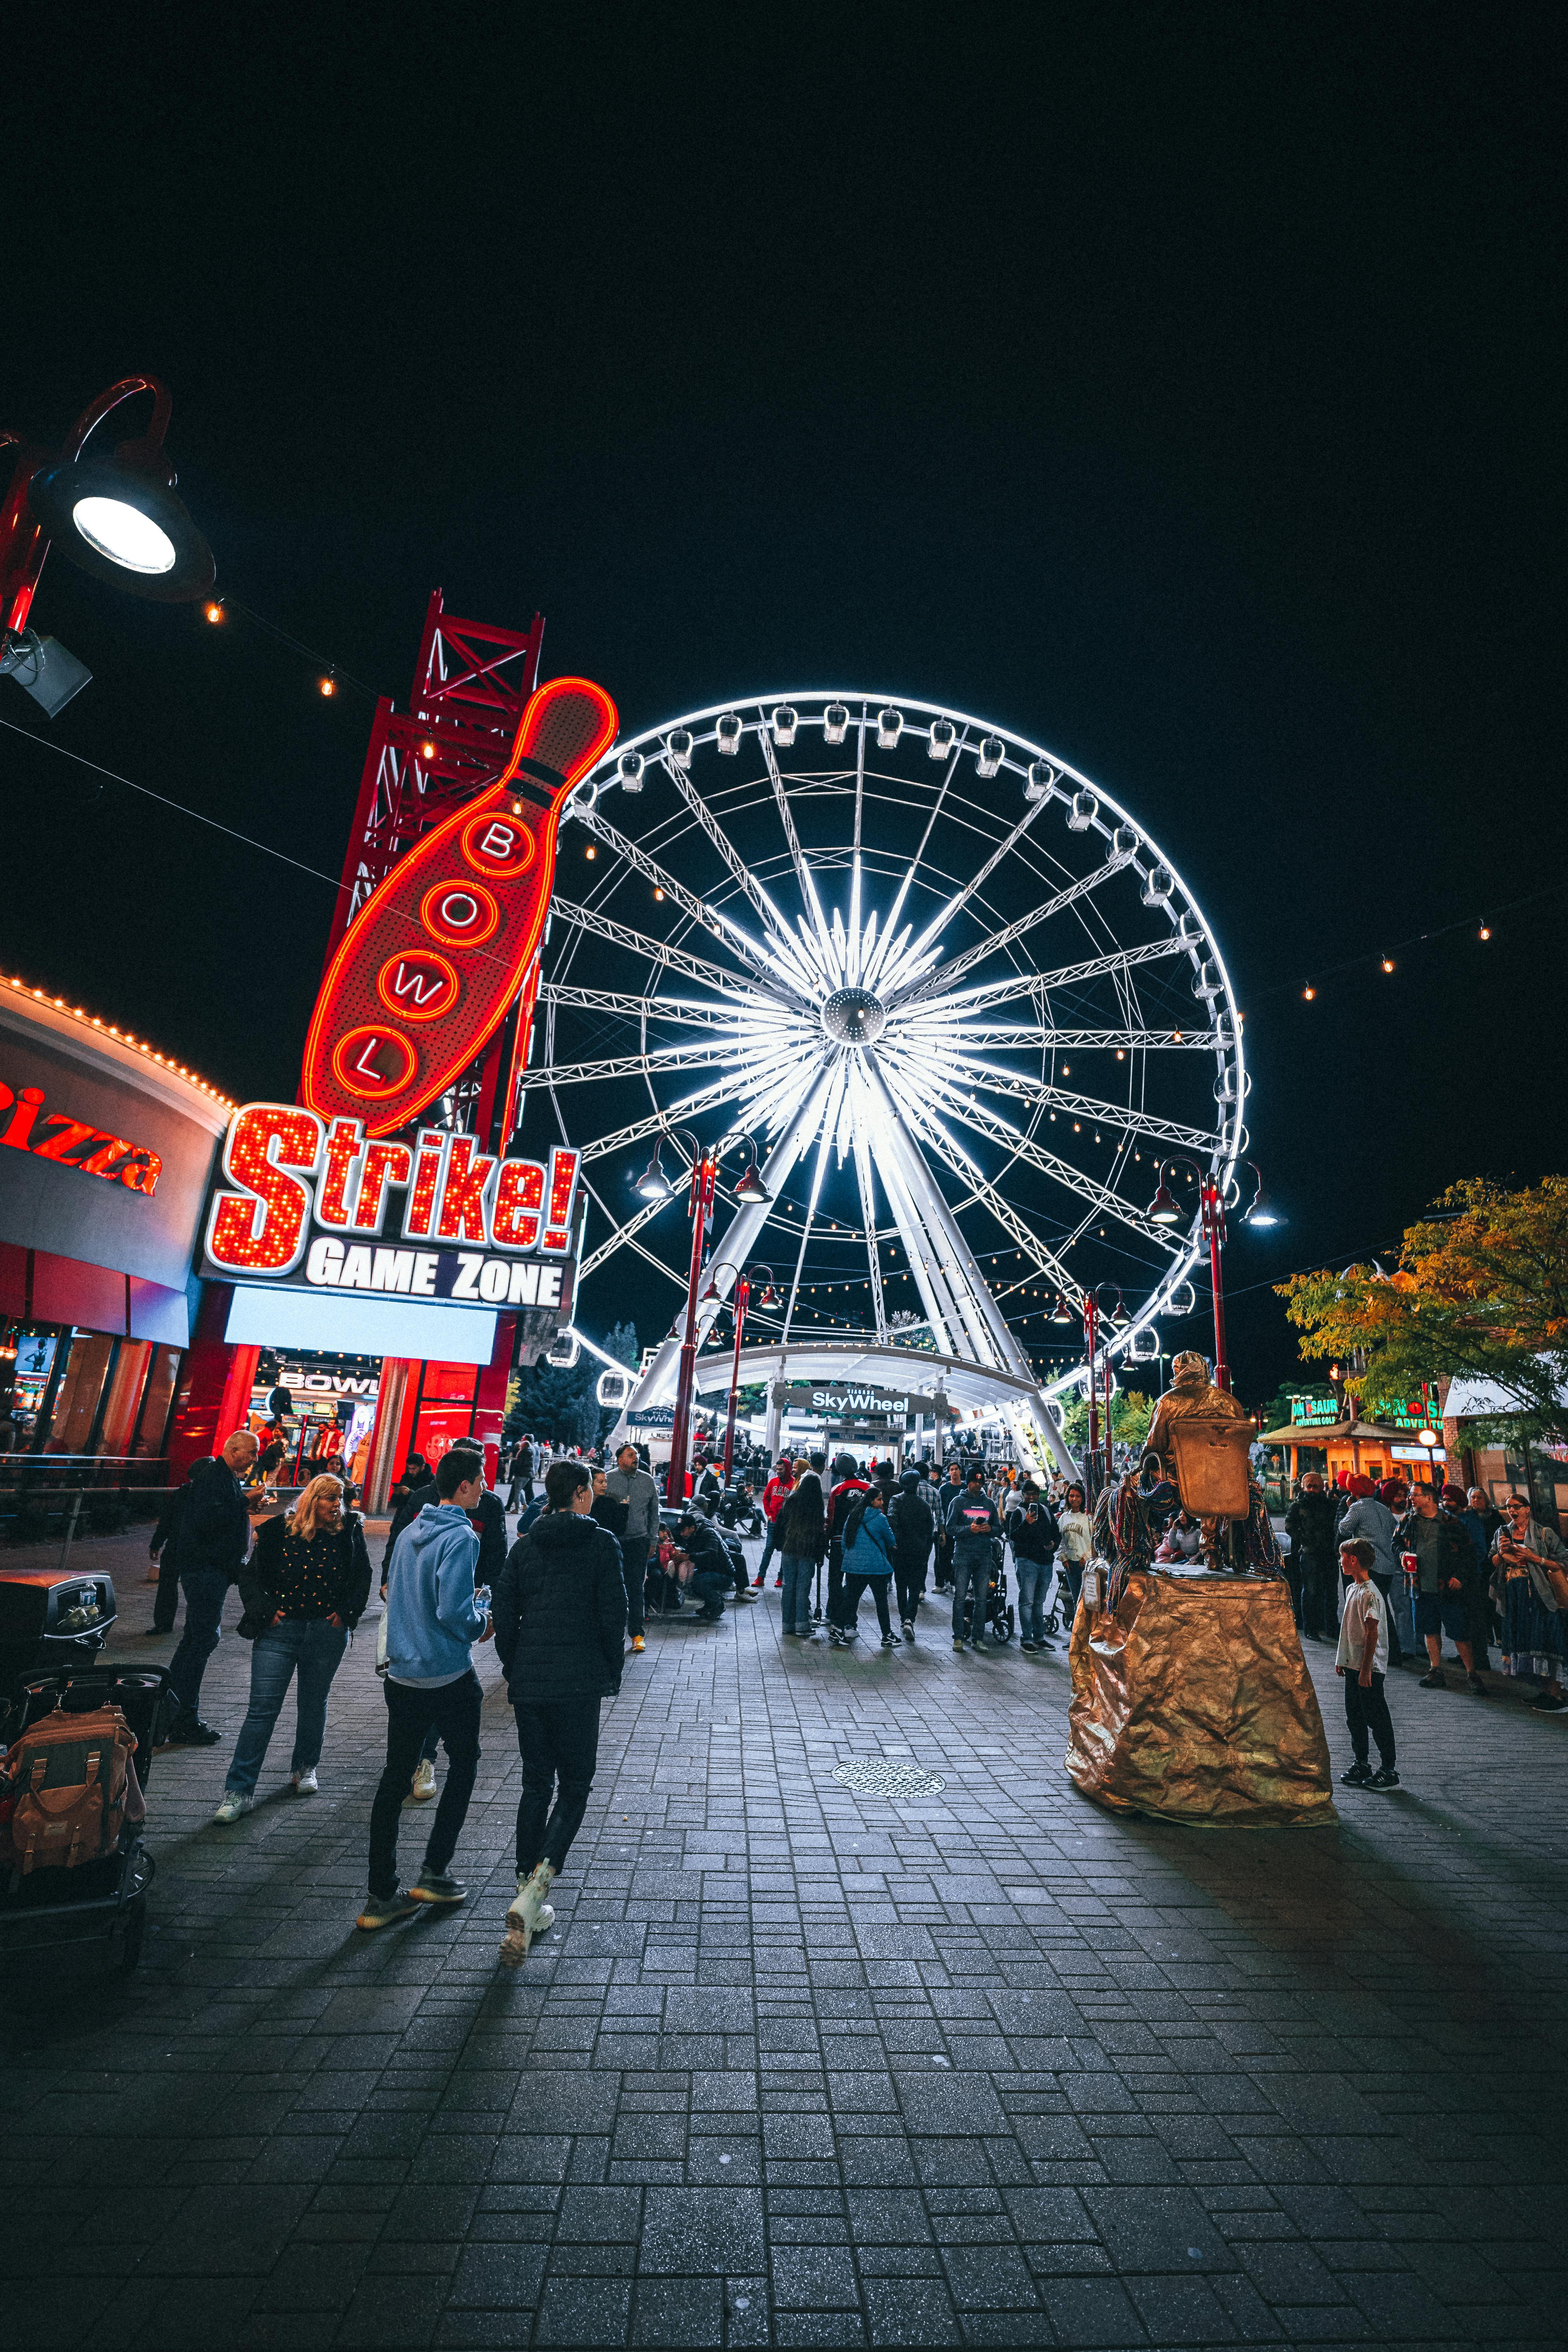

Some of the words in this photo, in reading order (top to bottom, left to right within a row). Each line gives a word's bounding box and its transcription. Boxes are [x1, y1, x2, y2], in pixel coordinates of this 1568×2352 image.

[205, 1102, 583, 1277] Strike!
[306, 1237, 438, 1295] GAME
[451, 1252, 564, 1307] ZONE
[812, 1391, 909, 1412] SkyWheel
[1296, 1417, 1321, 1427] ADVENTURE
[1322, 1416, 1336, 1425] GOLF
[772, 1486, 789, 1498] GAP
